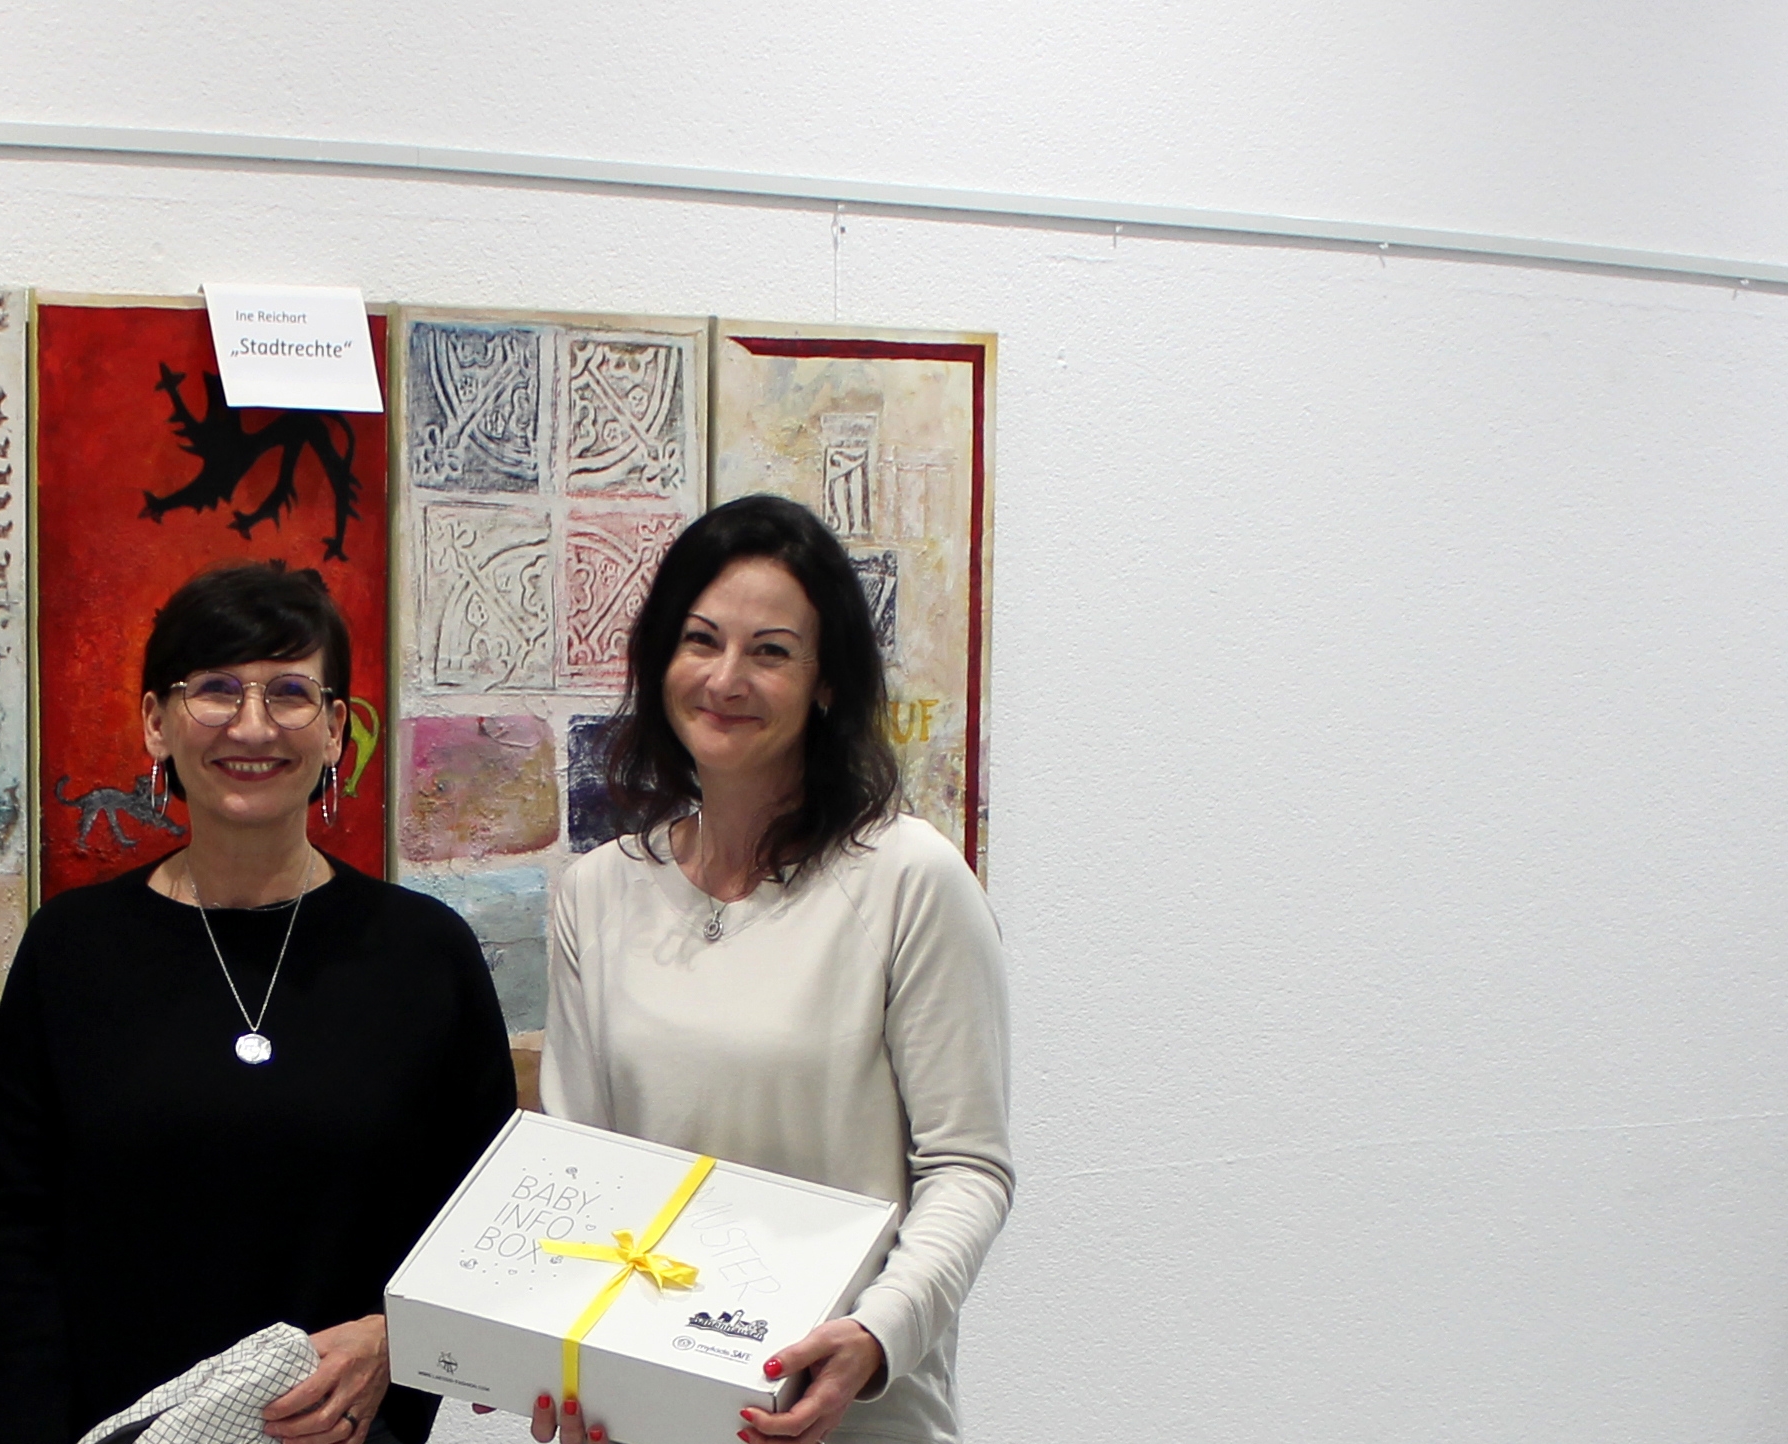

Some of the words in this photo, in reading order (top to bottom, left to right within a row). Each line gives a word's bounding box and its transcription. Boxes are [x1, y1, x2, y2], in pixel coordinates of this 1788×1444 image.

[235, 310, 254, 321] Ine
[257, 310, 307, 324] Reichart
[512, 1175, 601, 1214] BABY
[494, 1202, 574, 1240] INFO
[474, 1226, 542, 1265] BOX
[685, 1185, 782, 1302] MUSTER
